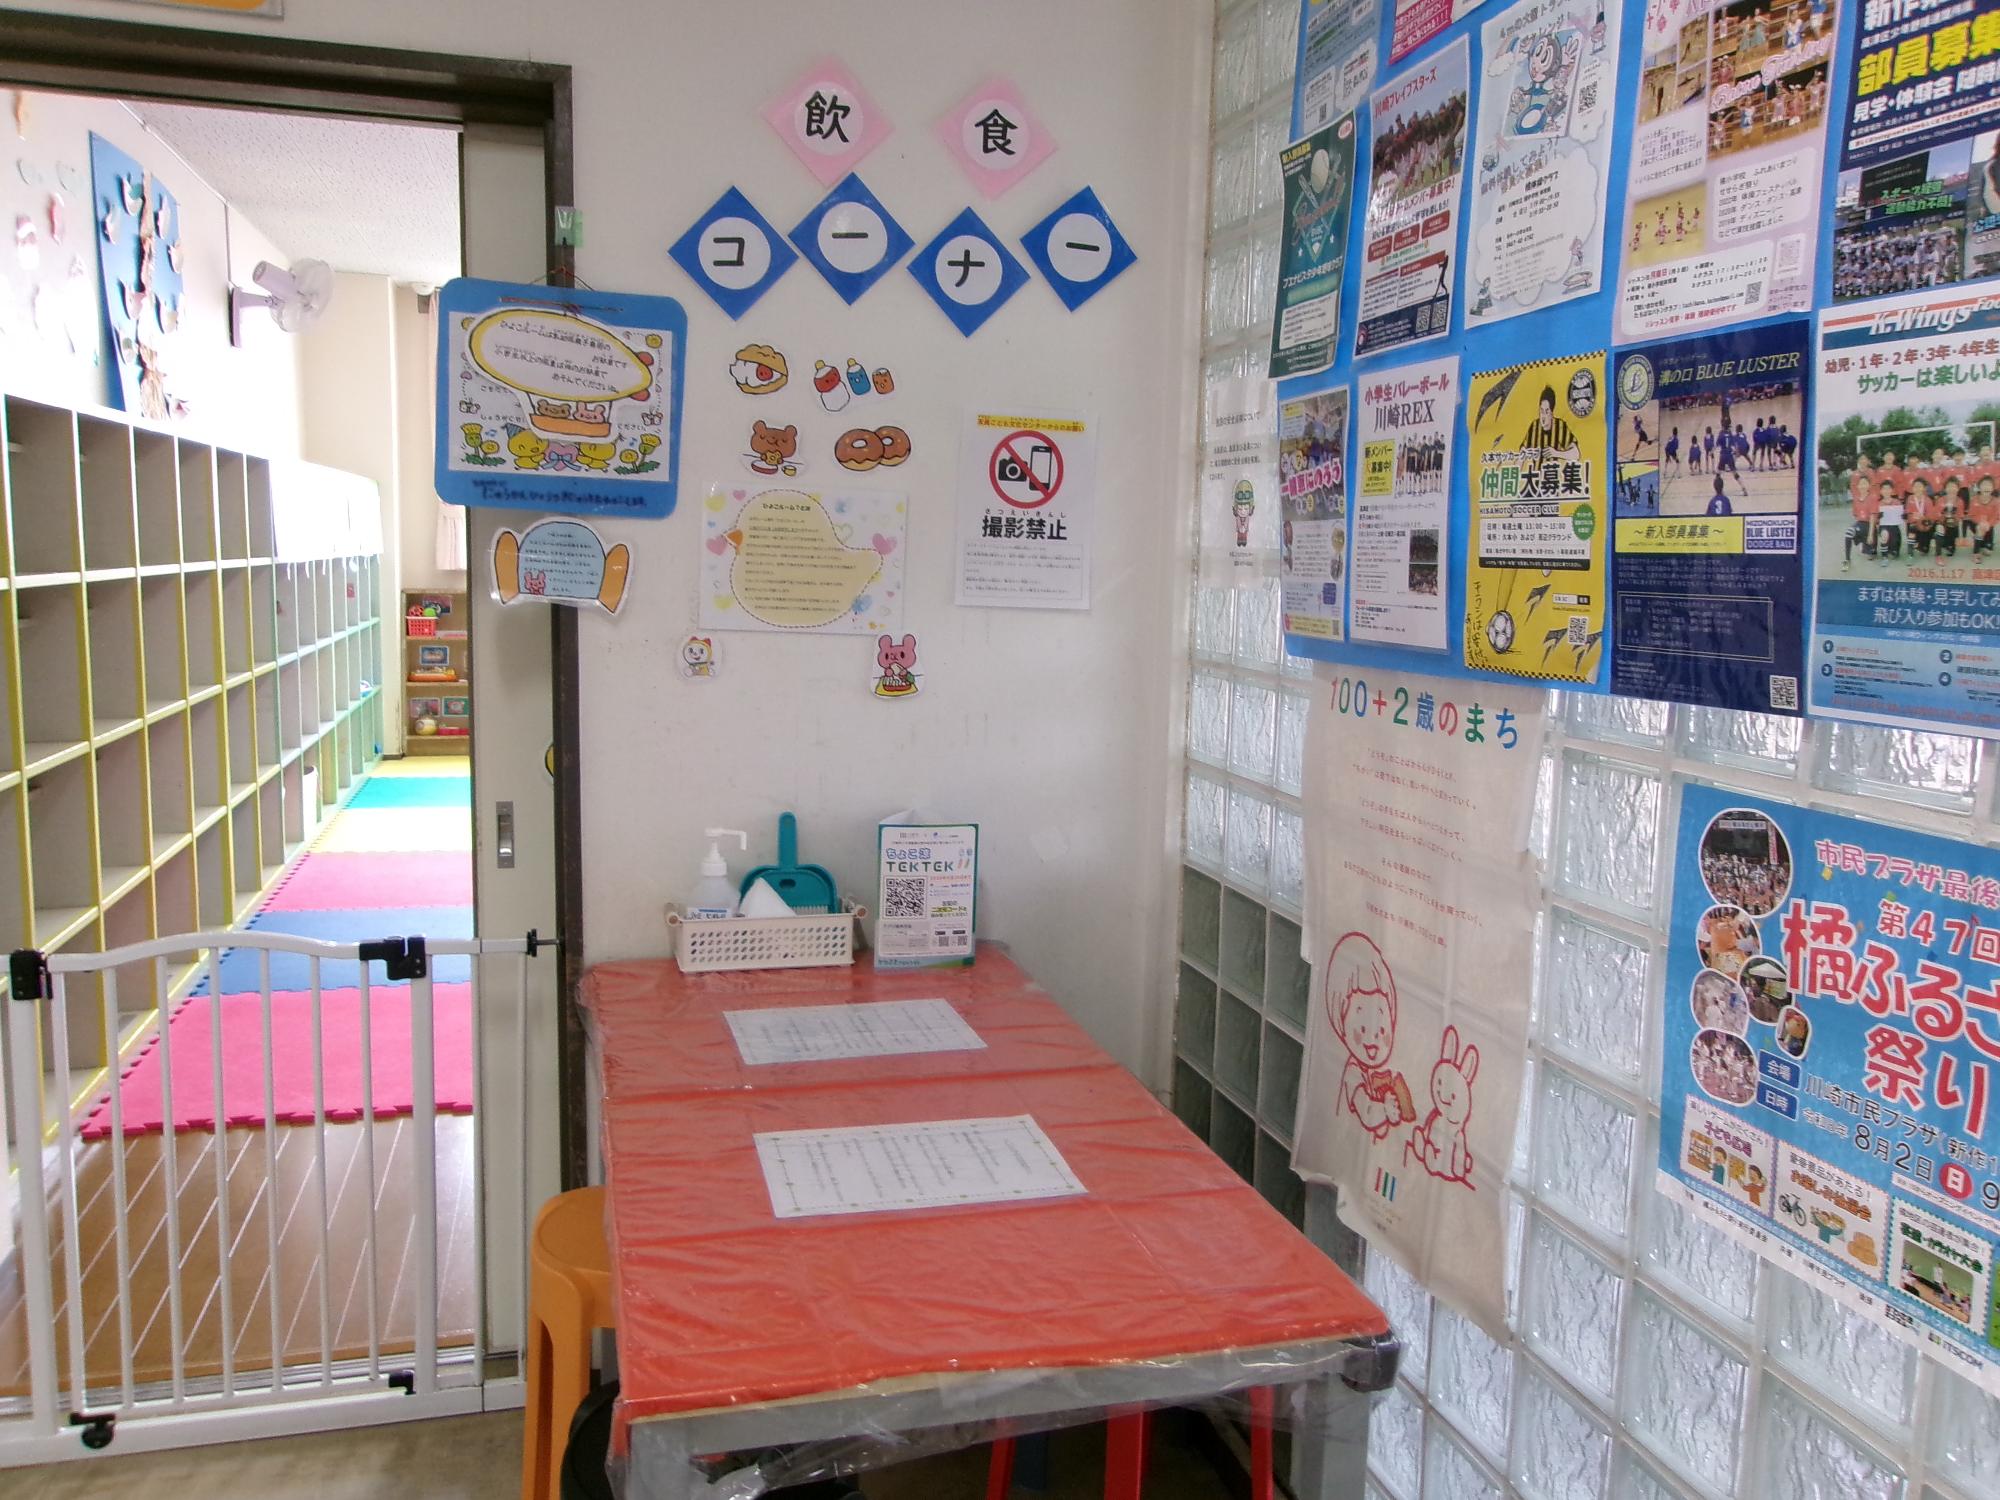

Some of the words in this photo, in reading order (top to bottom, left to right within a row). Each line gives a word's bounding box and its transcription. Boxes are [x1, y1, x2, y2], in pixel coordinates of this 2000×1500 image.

[1857, 10, 2000, 96] 部員募集
[1852, 75, 1953, 123] 見学・体験会
[1696, 361, 1735, 382] BLUE
[1737, 352, 1802, 374] LUSTER
[1364, 372, 1450, 404] 小学生バレーボール
[1373, 399, 1435, 432] 川崎REX
[1481, 447, 1541, 464] 久本サッカークラブ
[1480, 461, 1590, 499] 仲間大募集!
[985, 508, 1067, 519] さつえいきんし
[1479, 504, 1512, 515] HISAMOTO
[1513, 504, 1541, 514] SOCCER
[1542, 503, 1560, 514] CLUB
[981, 515, 1068, 541] 撮影禁止
[1746, 527, 1765, 538] BLUE
[1767, 527, 1795, 539] LUSTER
[1747, 539, 1774, 549] DODGE
[1775, 539, 1793, 549] BALL
[1329, 676, 1519, 750] 100+2歳のまち
[886, 861, 954, 873] TEKTEK
[1767, 1059, 1793, 1081] 会場
[1864, 1022, 1989, 1139] 祭り
[1765, 1089, 1789, 1113] 日時
